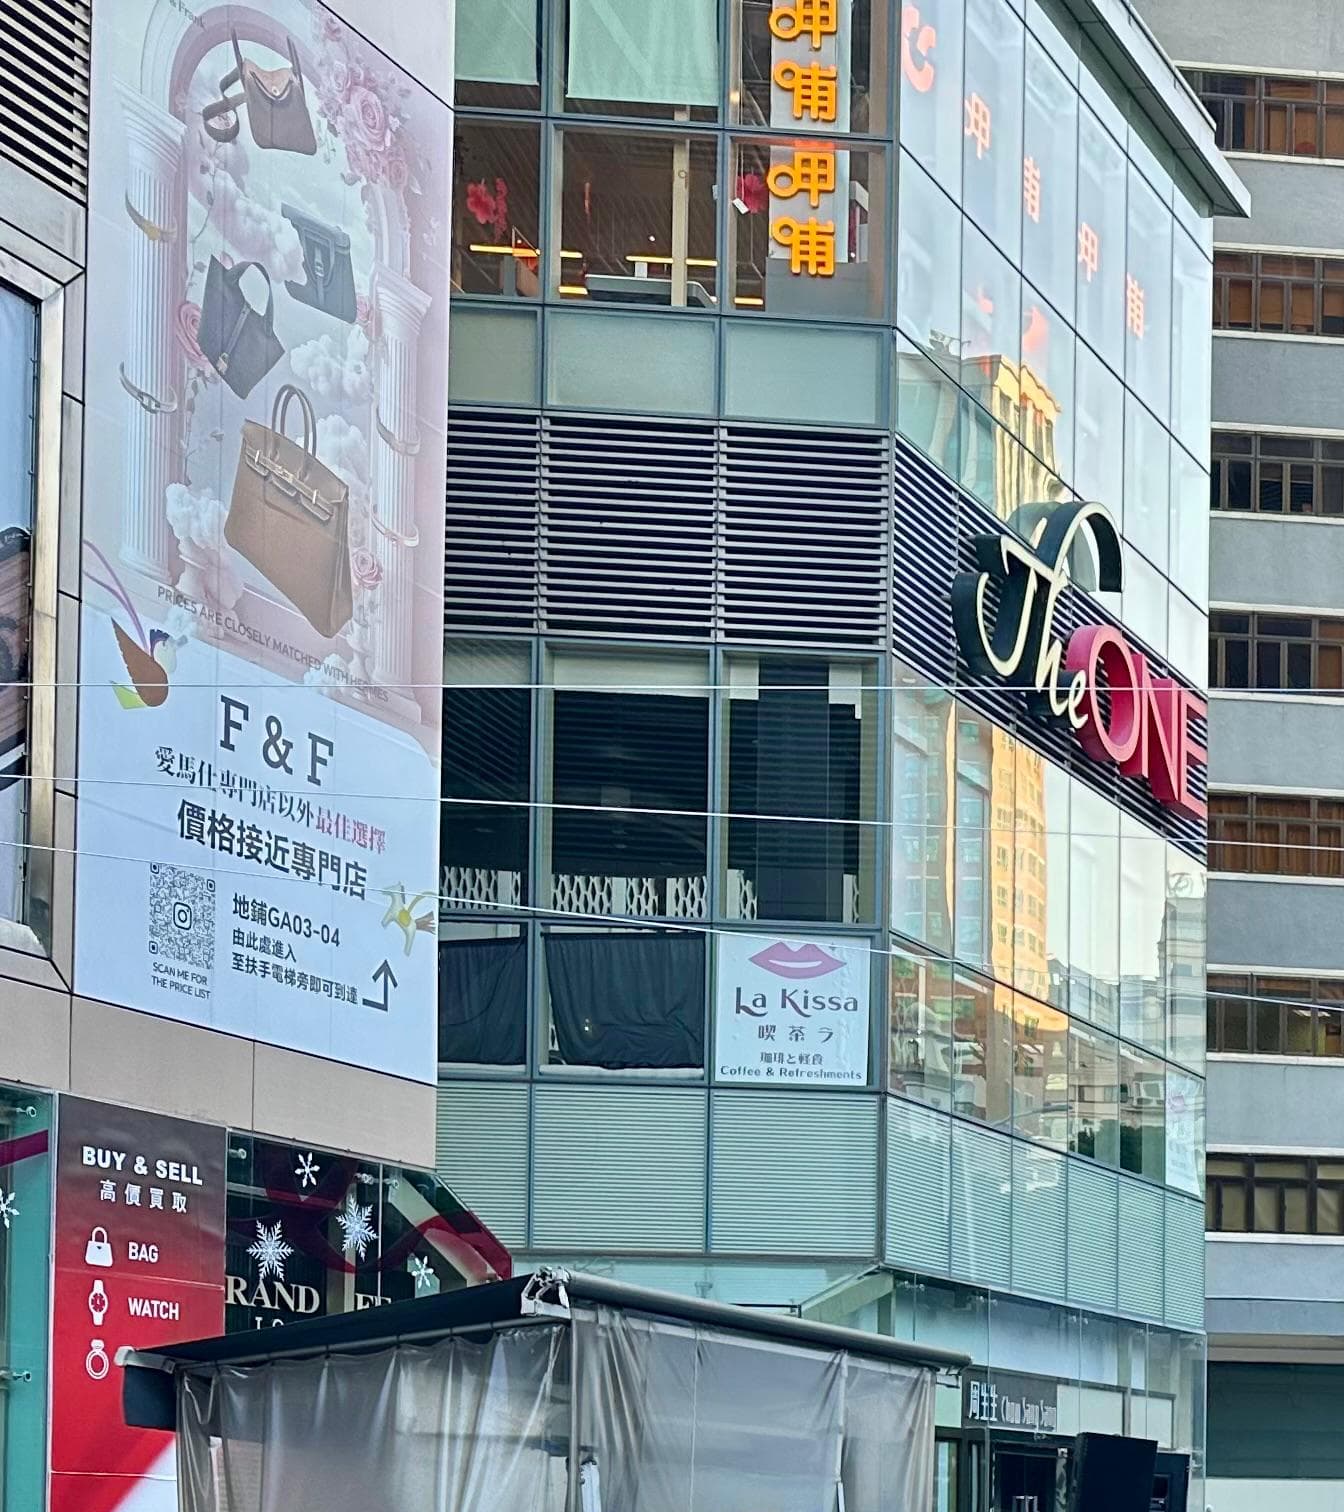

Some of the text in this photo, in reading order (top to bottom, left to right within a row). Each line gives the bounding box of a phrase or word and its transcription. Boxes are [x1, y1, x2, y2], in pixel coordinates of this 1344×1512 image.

[158, 586, 350, 684] PRICES ARE CLOSELY MATCHED WITH
[220, 695, 334, 786] F & F
[152, 961, 208, 986] SCAN ME FOR
[152, 976, 212, 1000] THE PRICE LIST
[735, 986, 859, 1018] La Kissa
[720, 1065, 863, 1080] Coffee & Refreshments
[81, 1145, 204, 1186] BUY & SELL
[99, 1180, 189, 1214] 高價買取
[127, 1242, 159, 1264] BAG
[128, 1298, 180, 1321] WATCH
